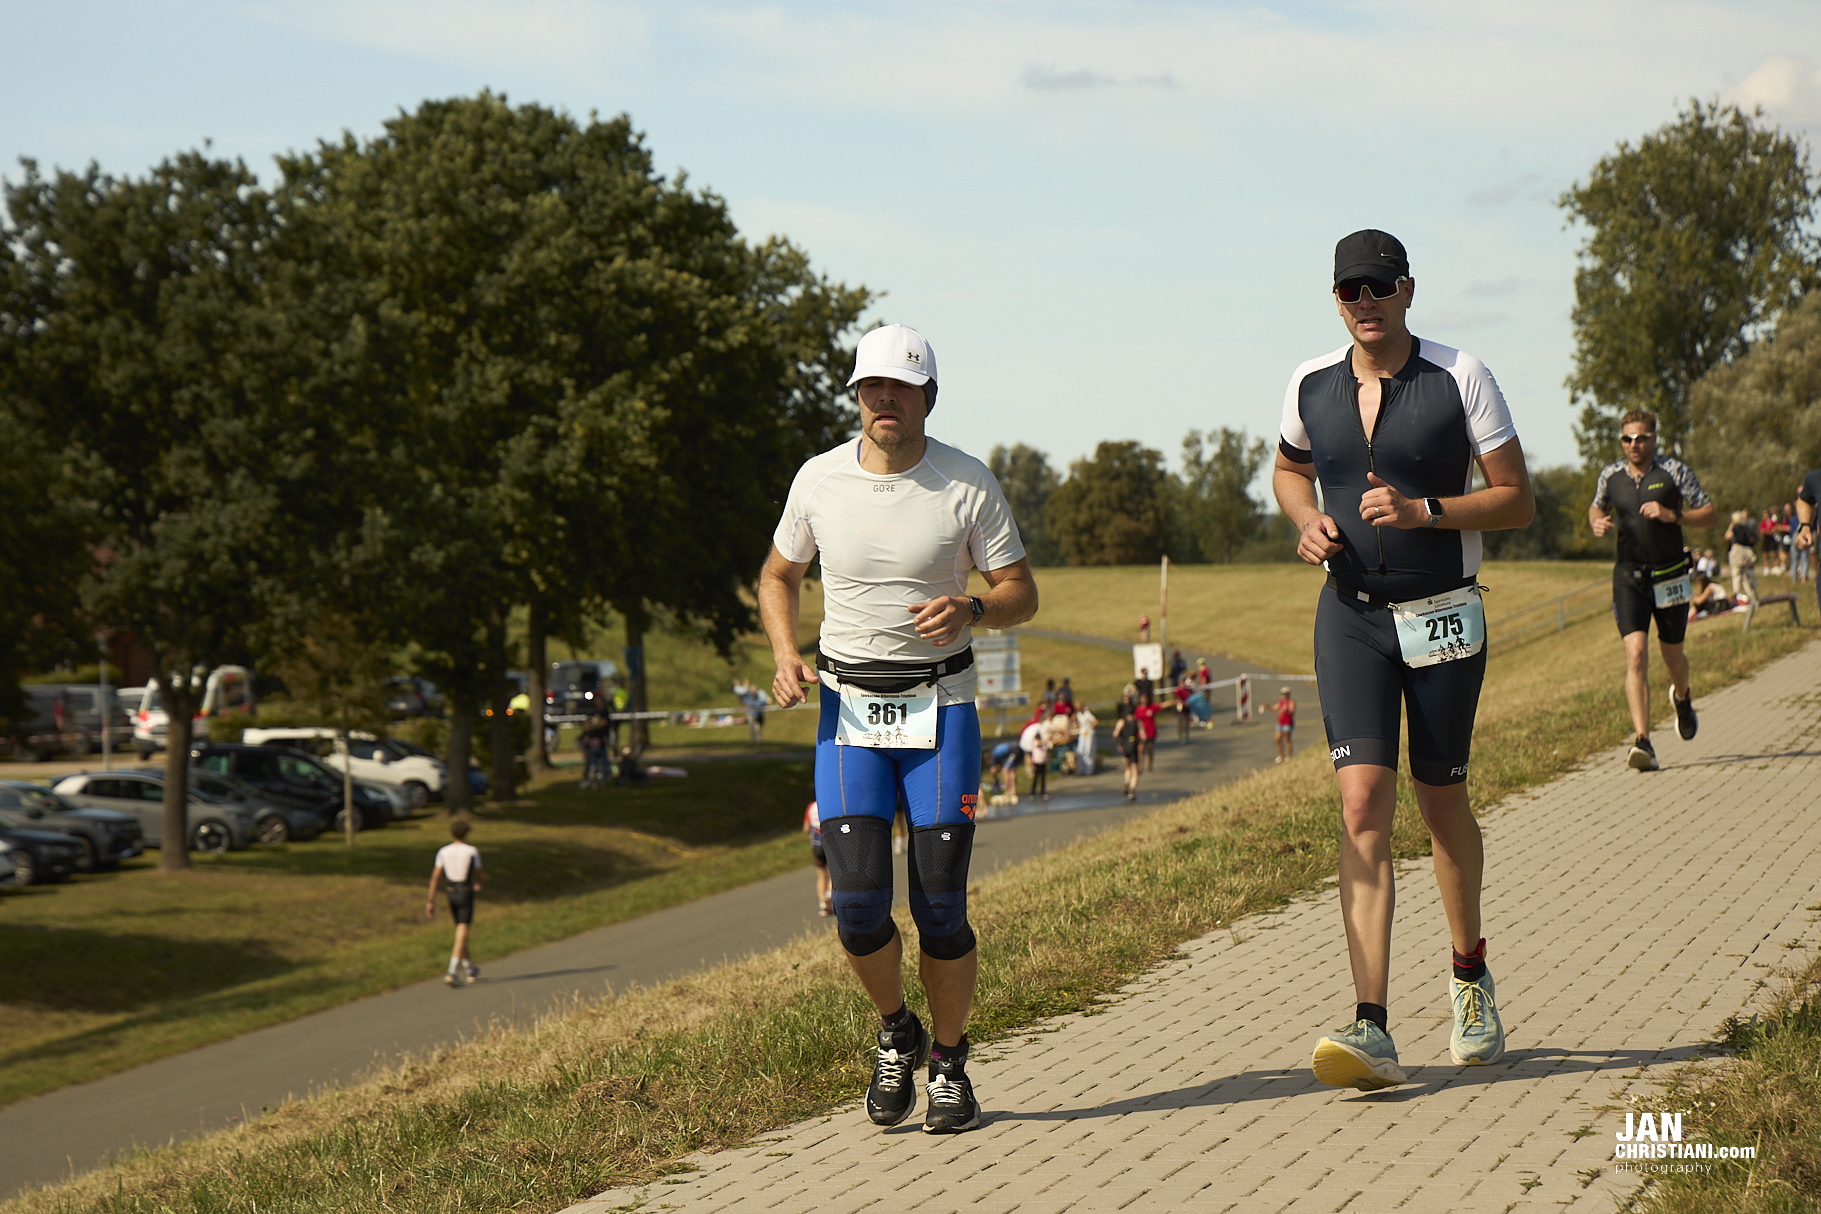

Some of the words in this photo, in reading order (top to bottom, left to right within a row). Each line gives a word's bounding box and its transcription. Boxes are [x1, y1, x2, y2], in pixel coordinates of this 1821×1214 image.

[873, 485, 896, 493] GORE
[1666, 584, 1684, 597] 381
[1425, 612, 1464, 642] 275
[868, 702, 907, 725] 361
